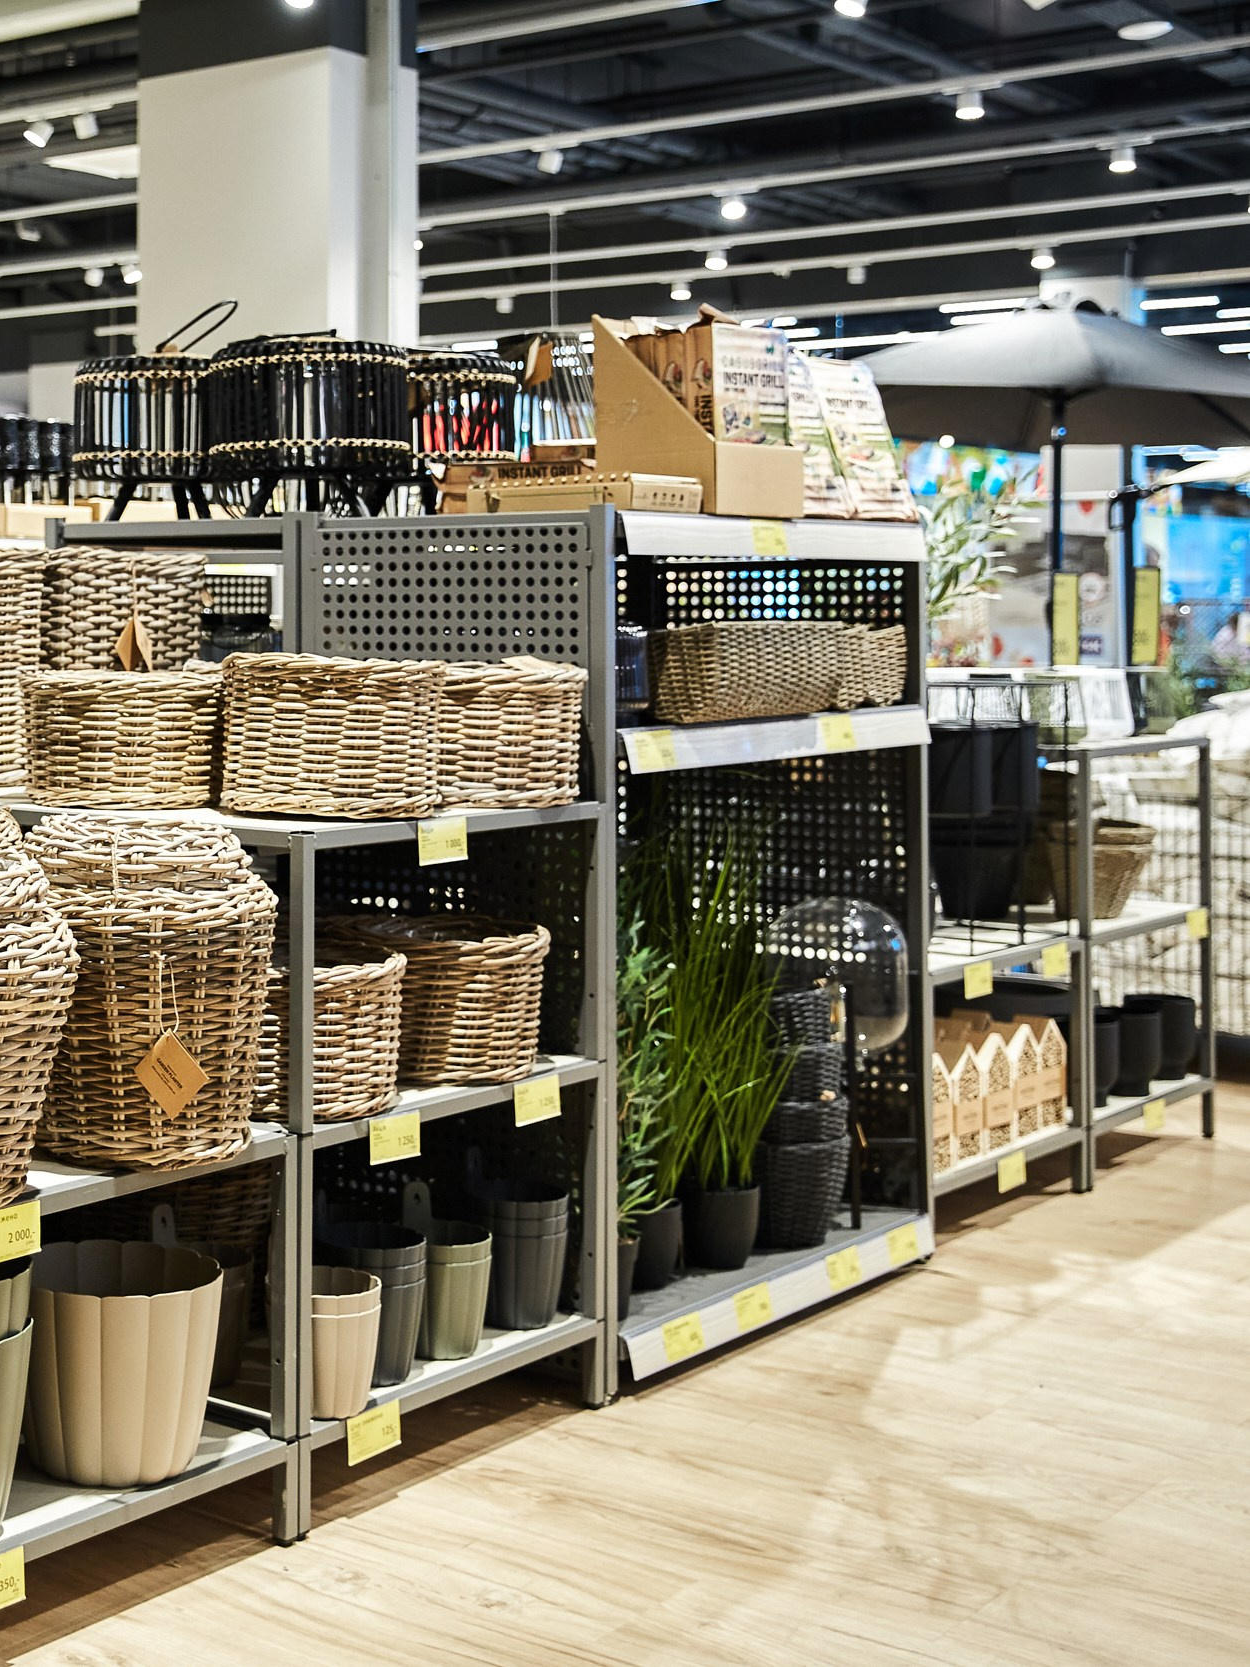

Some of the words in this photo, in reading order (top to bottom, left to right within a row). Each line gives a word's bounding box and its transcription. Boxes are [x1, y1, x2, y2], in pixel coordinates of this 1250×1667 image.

[723, 371, 759, 387] INSTANT
[760, 374, 785, 389] GRILL
[497, 465, 548, 479] INSTANT
[156, 1057, 170, 1075] GARDEN
[168, 1070, 183, 1090] PLANTER
